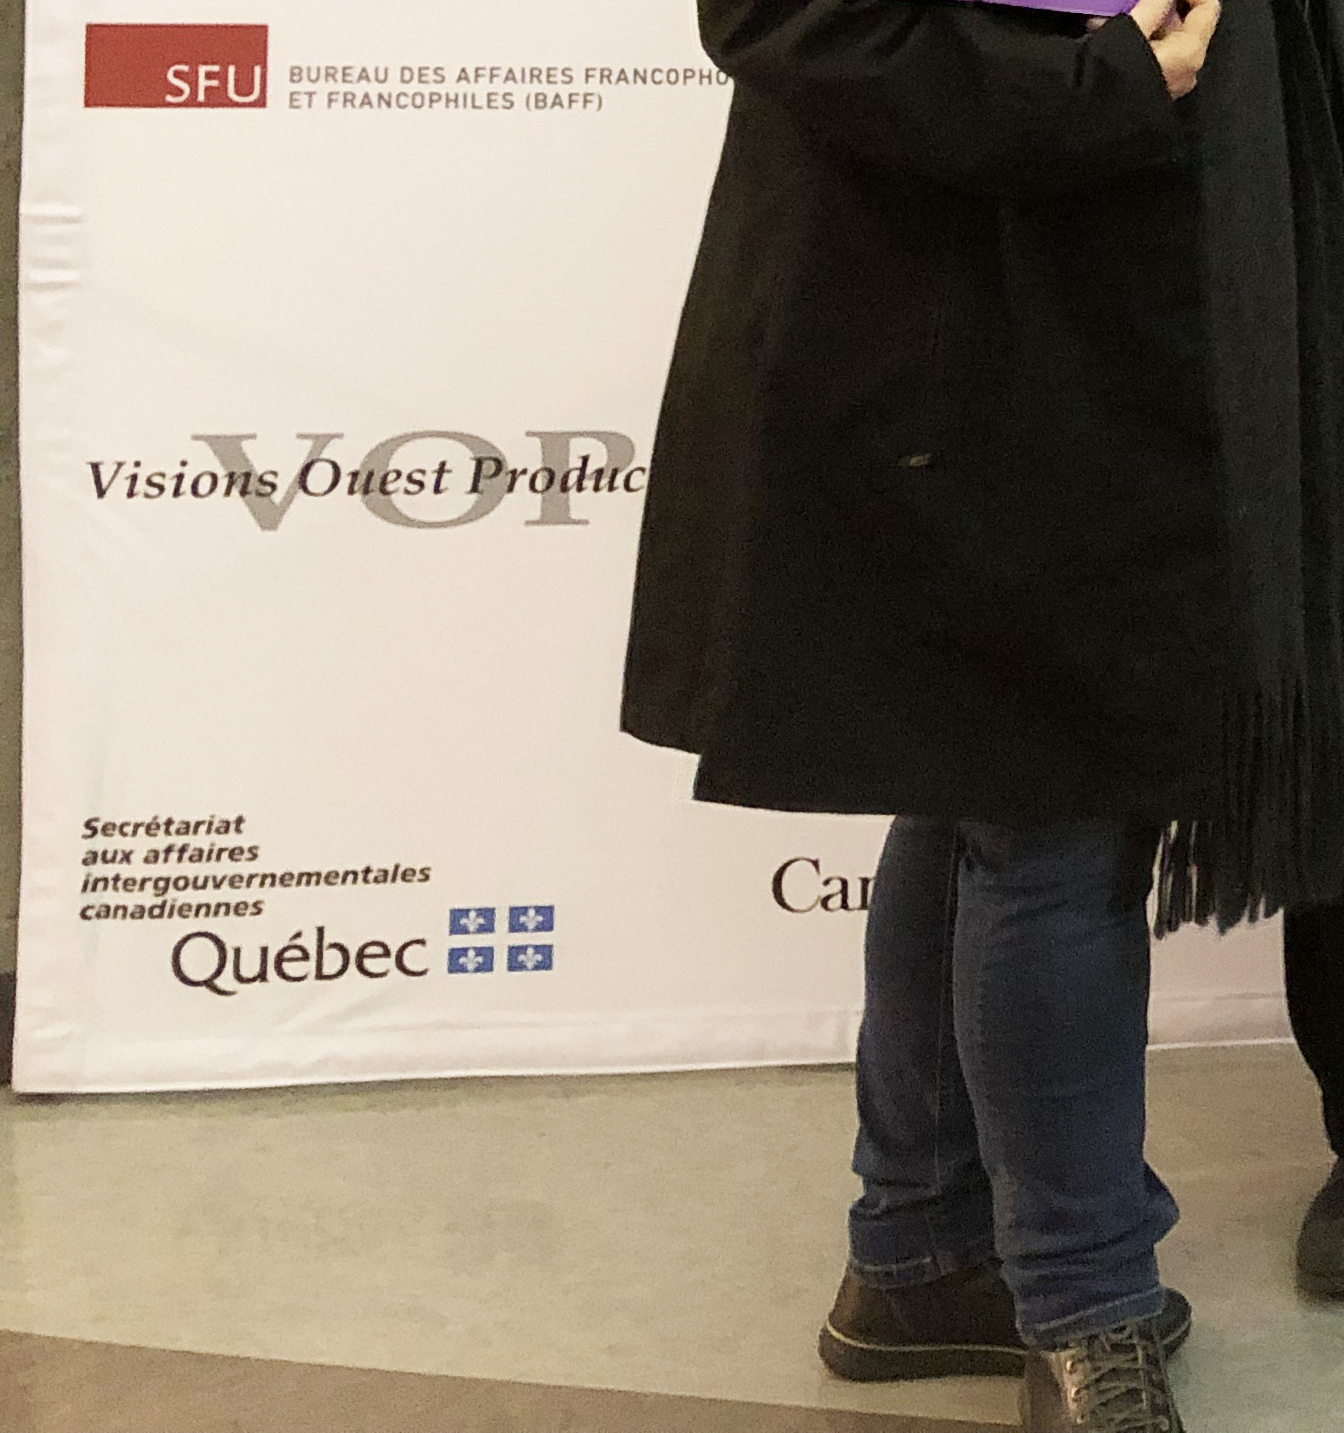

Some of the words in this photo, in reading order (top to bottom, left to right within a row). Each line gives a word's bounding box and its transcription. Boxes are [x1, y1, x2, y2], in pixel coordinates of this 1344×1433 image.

[165, 64, 262, 103] SFU
[289, 65, 389, 85] BUREAU
[400, 65, 446, 85] DES
[454, 66, 575, 85] AFFAIRES
[584, 67, 730, 86] FRANCOPHO
[289, 91, 317, 110] ET
[326, 91, 515, 111] FRANCOPHILES
[524, 90, 604, 112] (BAFF)
[87, 461, 279, 499] Visions
[300, 455, 453, 498] Ouest
[465, 454, 646, 495] Produc
[191, 430, 637, 532] VOP
[81, 815, 246, 840] Secrétariat
[81, 845, 133, 867] aux
[142, 842, 260, 866] affaires
[80, 864, 431, 897] intergouvernementales
[79, 896, 265, 922] canadiennes
[171, 926, 429, 996] Québec
